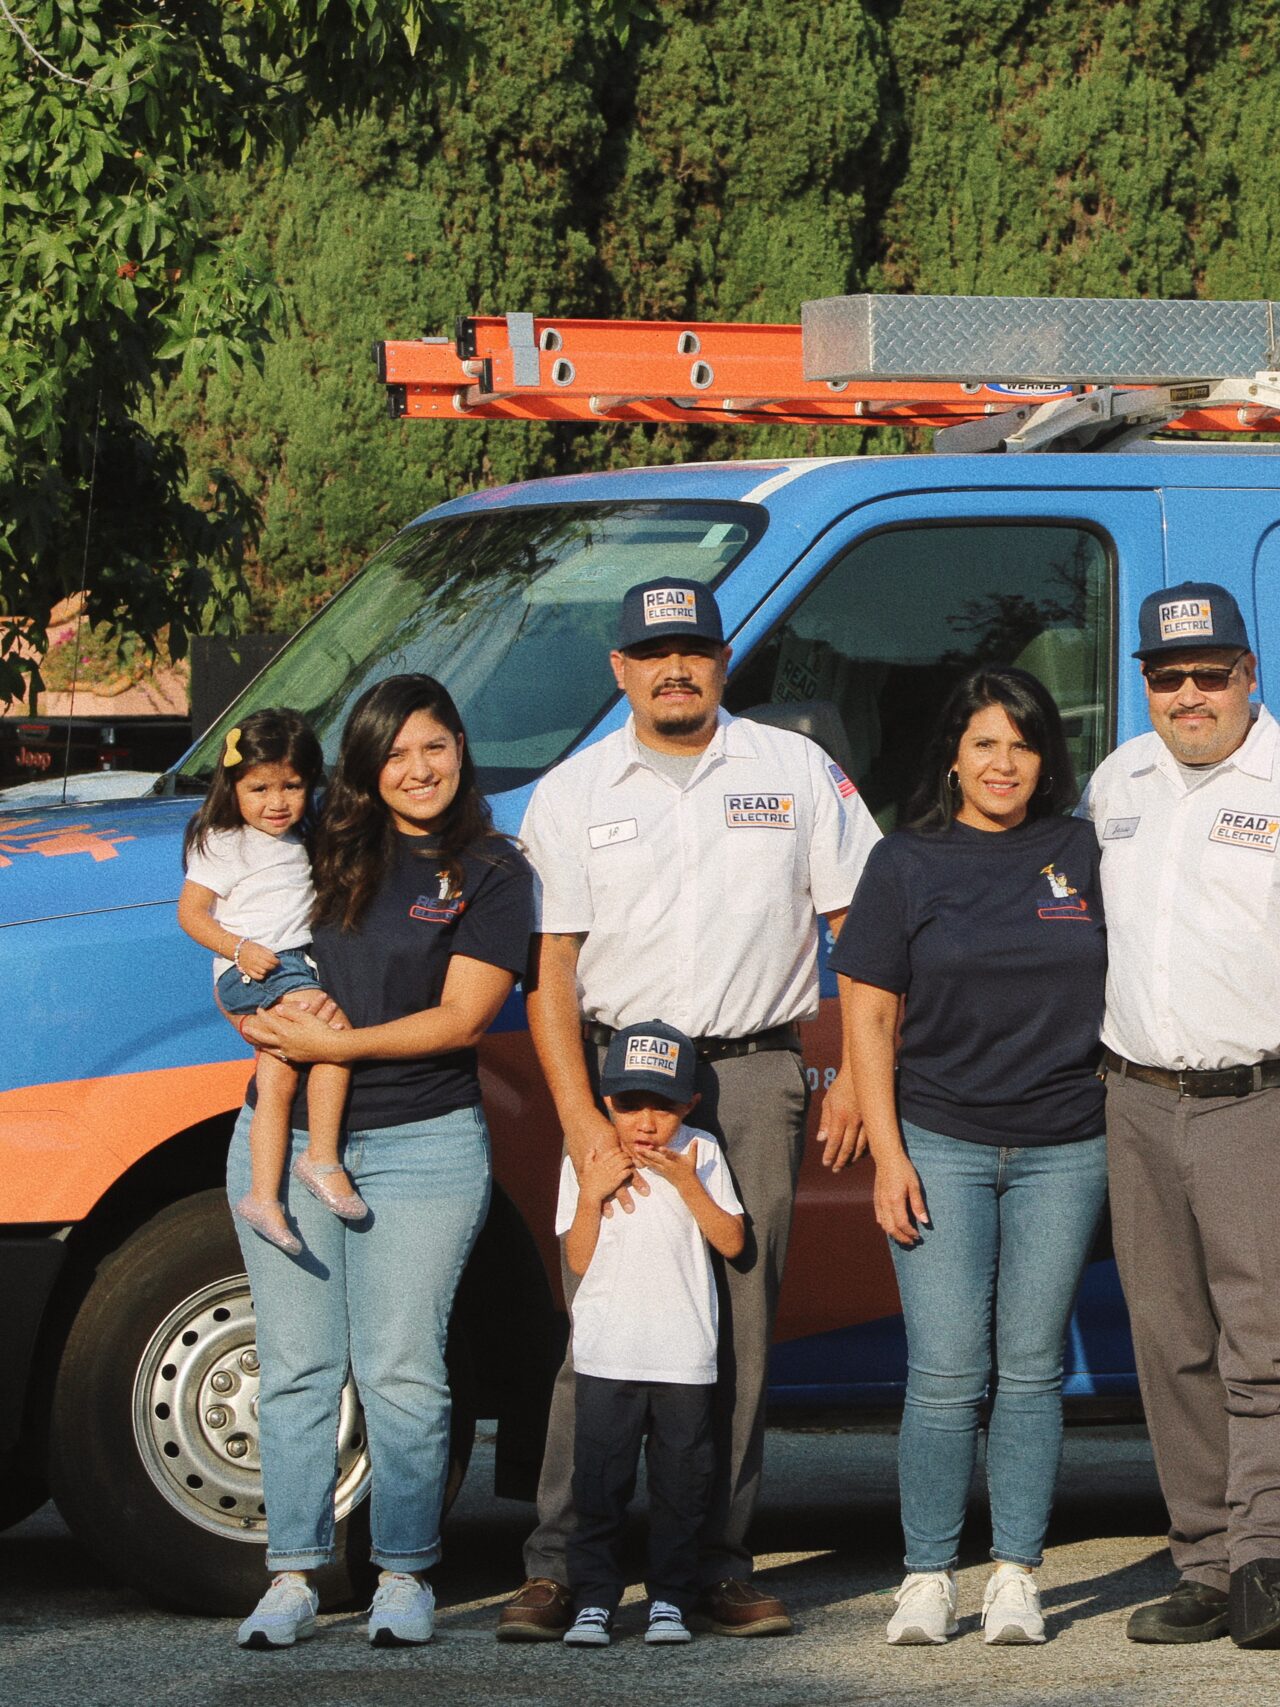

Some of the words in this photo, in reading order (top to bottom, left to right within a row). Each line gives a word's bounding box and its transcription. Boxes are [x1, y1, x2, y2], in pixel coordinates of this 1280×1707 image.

[646, 591, 685, 607] READ
[648, 607, 694, 619] ELECTRIC
[1161, 602, 1200, 621] READ
[1164, 620, 1209, 634] ELECTRIC
[729, 796, 780, 810] READ
[733, 812, 790, 823] ELECTRIC
[1220, 813, 1268, 831] READ
[1217, 828, 1273, 845] ELECTRIC
[629, 1039, 669, 1055] READ
[629, 1055, 675, 1071] ELECTRIC
